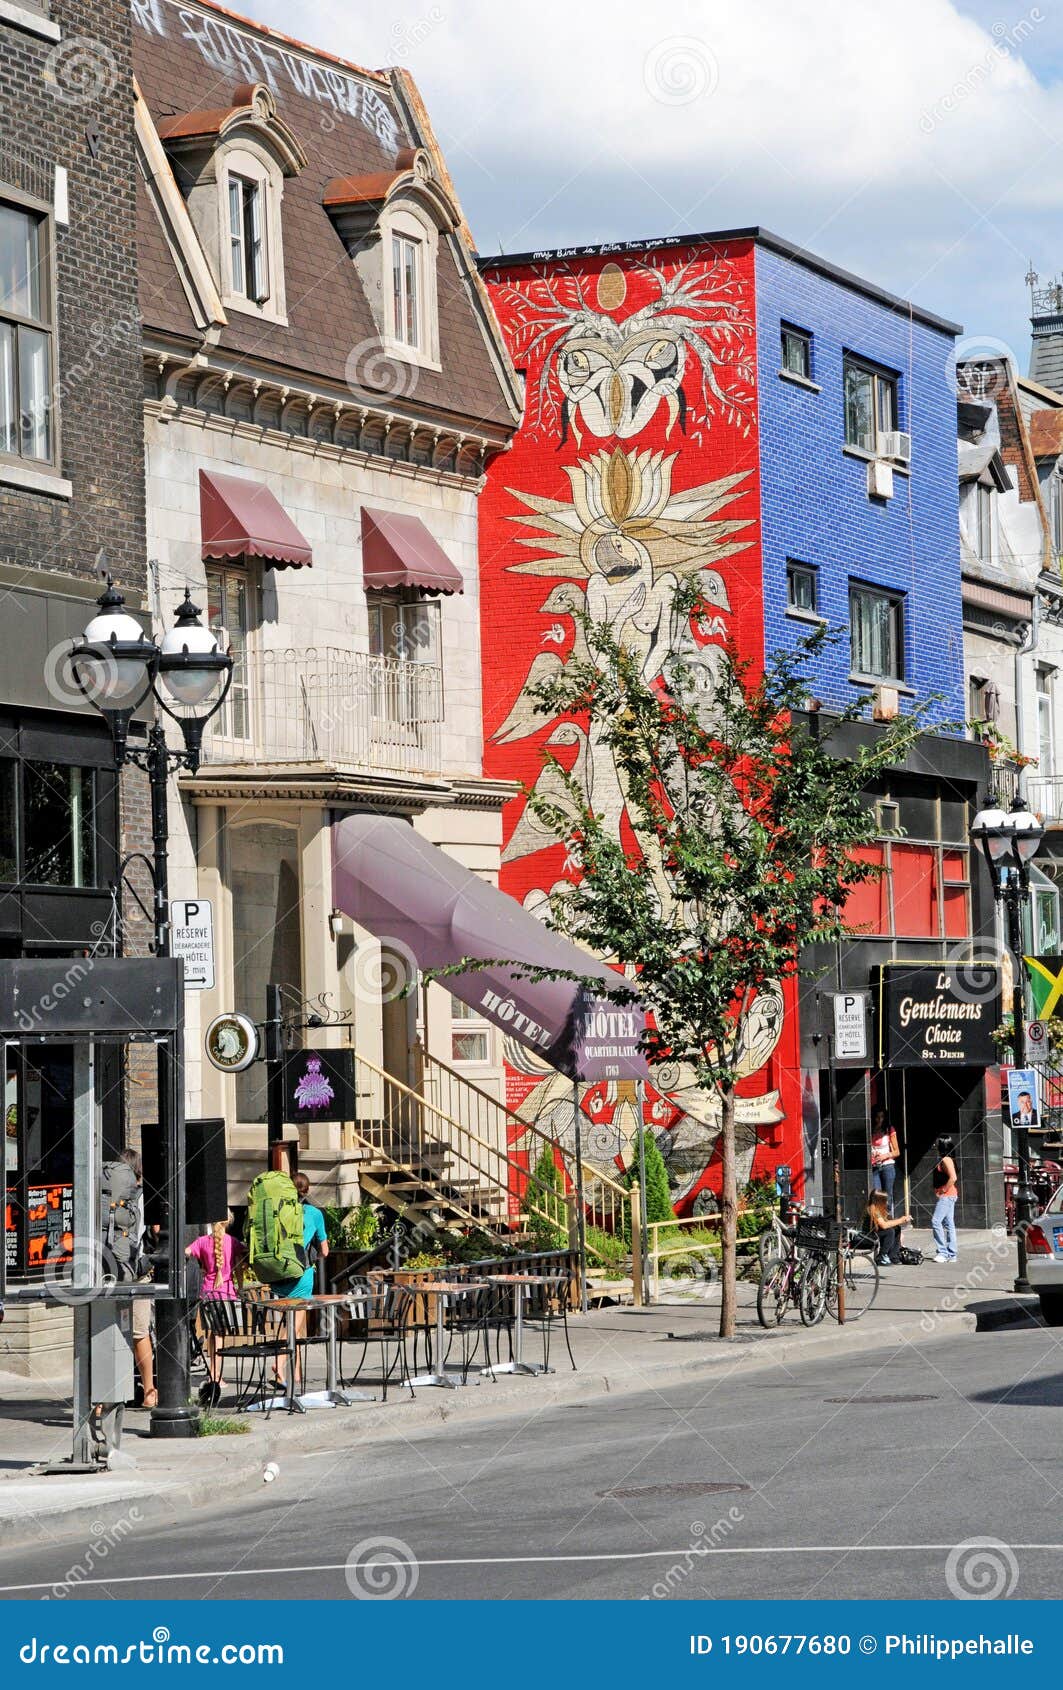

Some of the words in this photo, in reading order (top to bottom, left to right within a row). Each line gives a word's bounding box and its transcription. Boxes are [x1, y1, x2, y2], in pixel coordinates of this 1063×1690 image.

[184, 902, 199, 926] P
[935, 972, 951, 990] Le
[844, 996, 855, 1013] P
[899, 994, 983, 1028] Gentlemens
[480, 988, 552, 1051] HÔTEL
[583, 1005, 638, 1039] HÔTEL
[924, 1023, 962, 1045] Choice
[585, 1045, 618, 1060] QUARTIER
